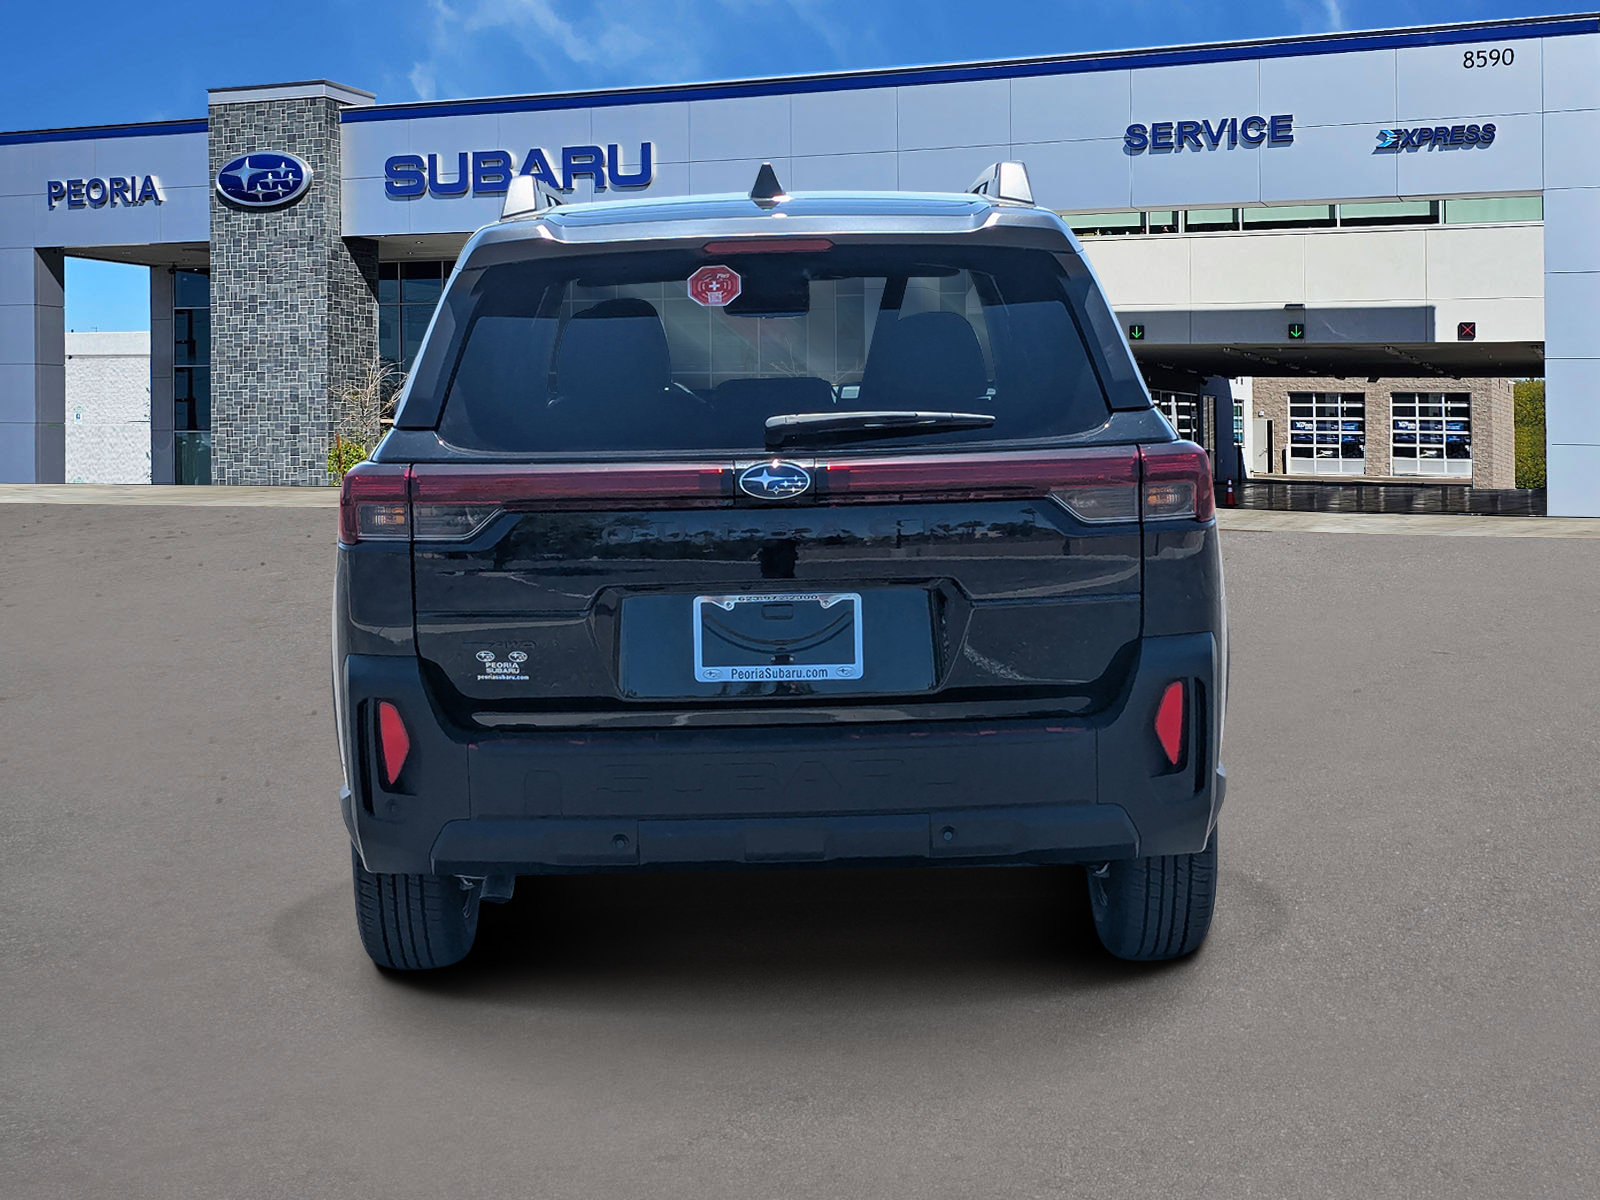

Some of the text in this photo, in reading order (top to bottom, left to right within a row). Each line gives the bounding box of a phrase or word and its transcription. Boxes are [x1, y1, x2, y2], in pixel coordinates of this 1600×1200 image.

[1463, 48, 1515, 69] 8590
[1125, 114, 1294, 150] SERVICE
[1376, 123, 1497, 148] EXPRESS
[384, 142, 652, 197] SUBARU
[47, 175, 162, 208] PEORIA
[731, 667, 828, 679] PeoriaSubaru.com
